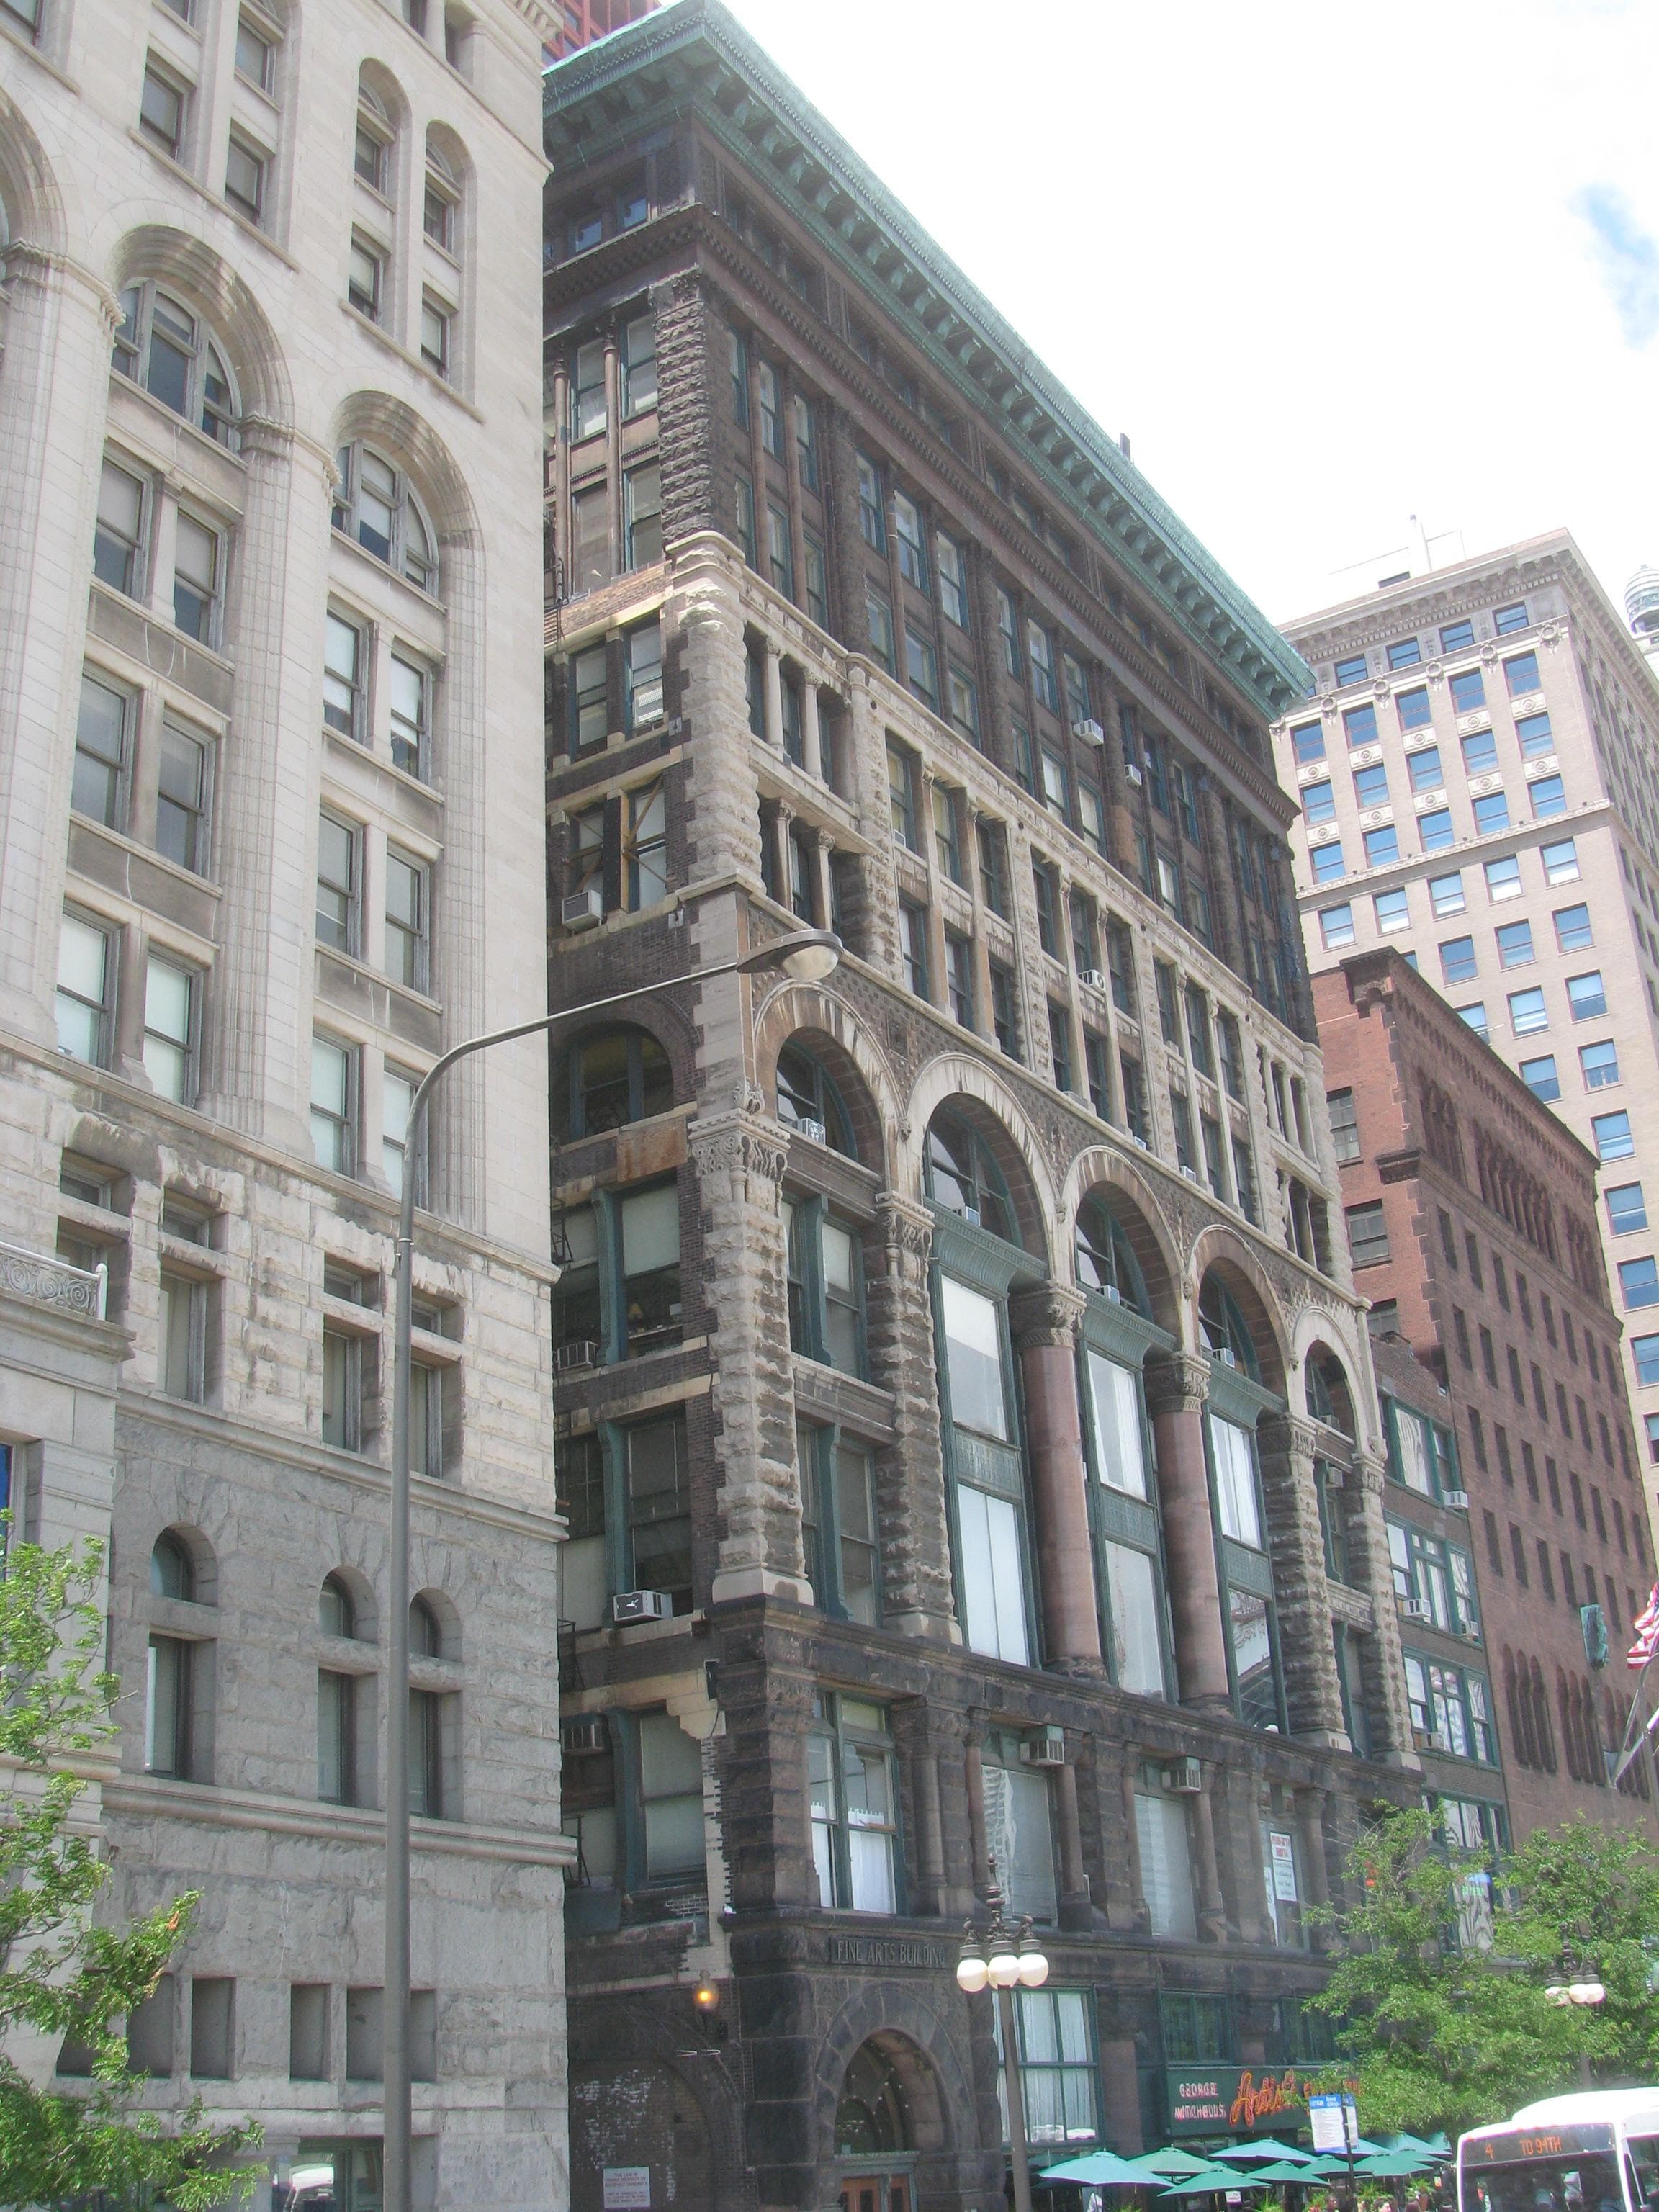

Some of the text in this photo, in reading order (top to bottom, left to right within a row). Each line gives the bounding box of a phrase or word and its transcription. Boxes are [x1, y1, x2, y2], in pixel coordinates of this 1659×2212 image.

[837, 1940, 945, 1965] FINE ARTS BUILDING
[1179, 2082, 1218, 2098] GEORGE
[1519, 2138, 1534, 2155] TO
